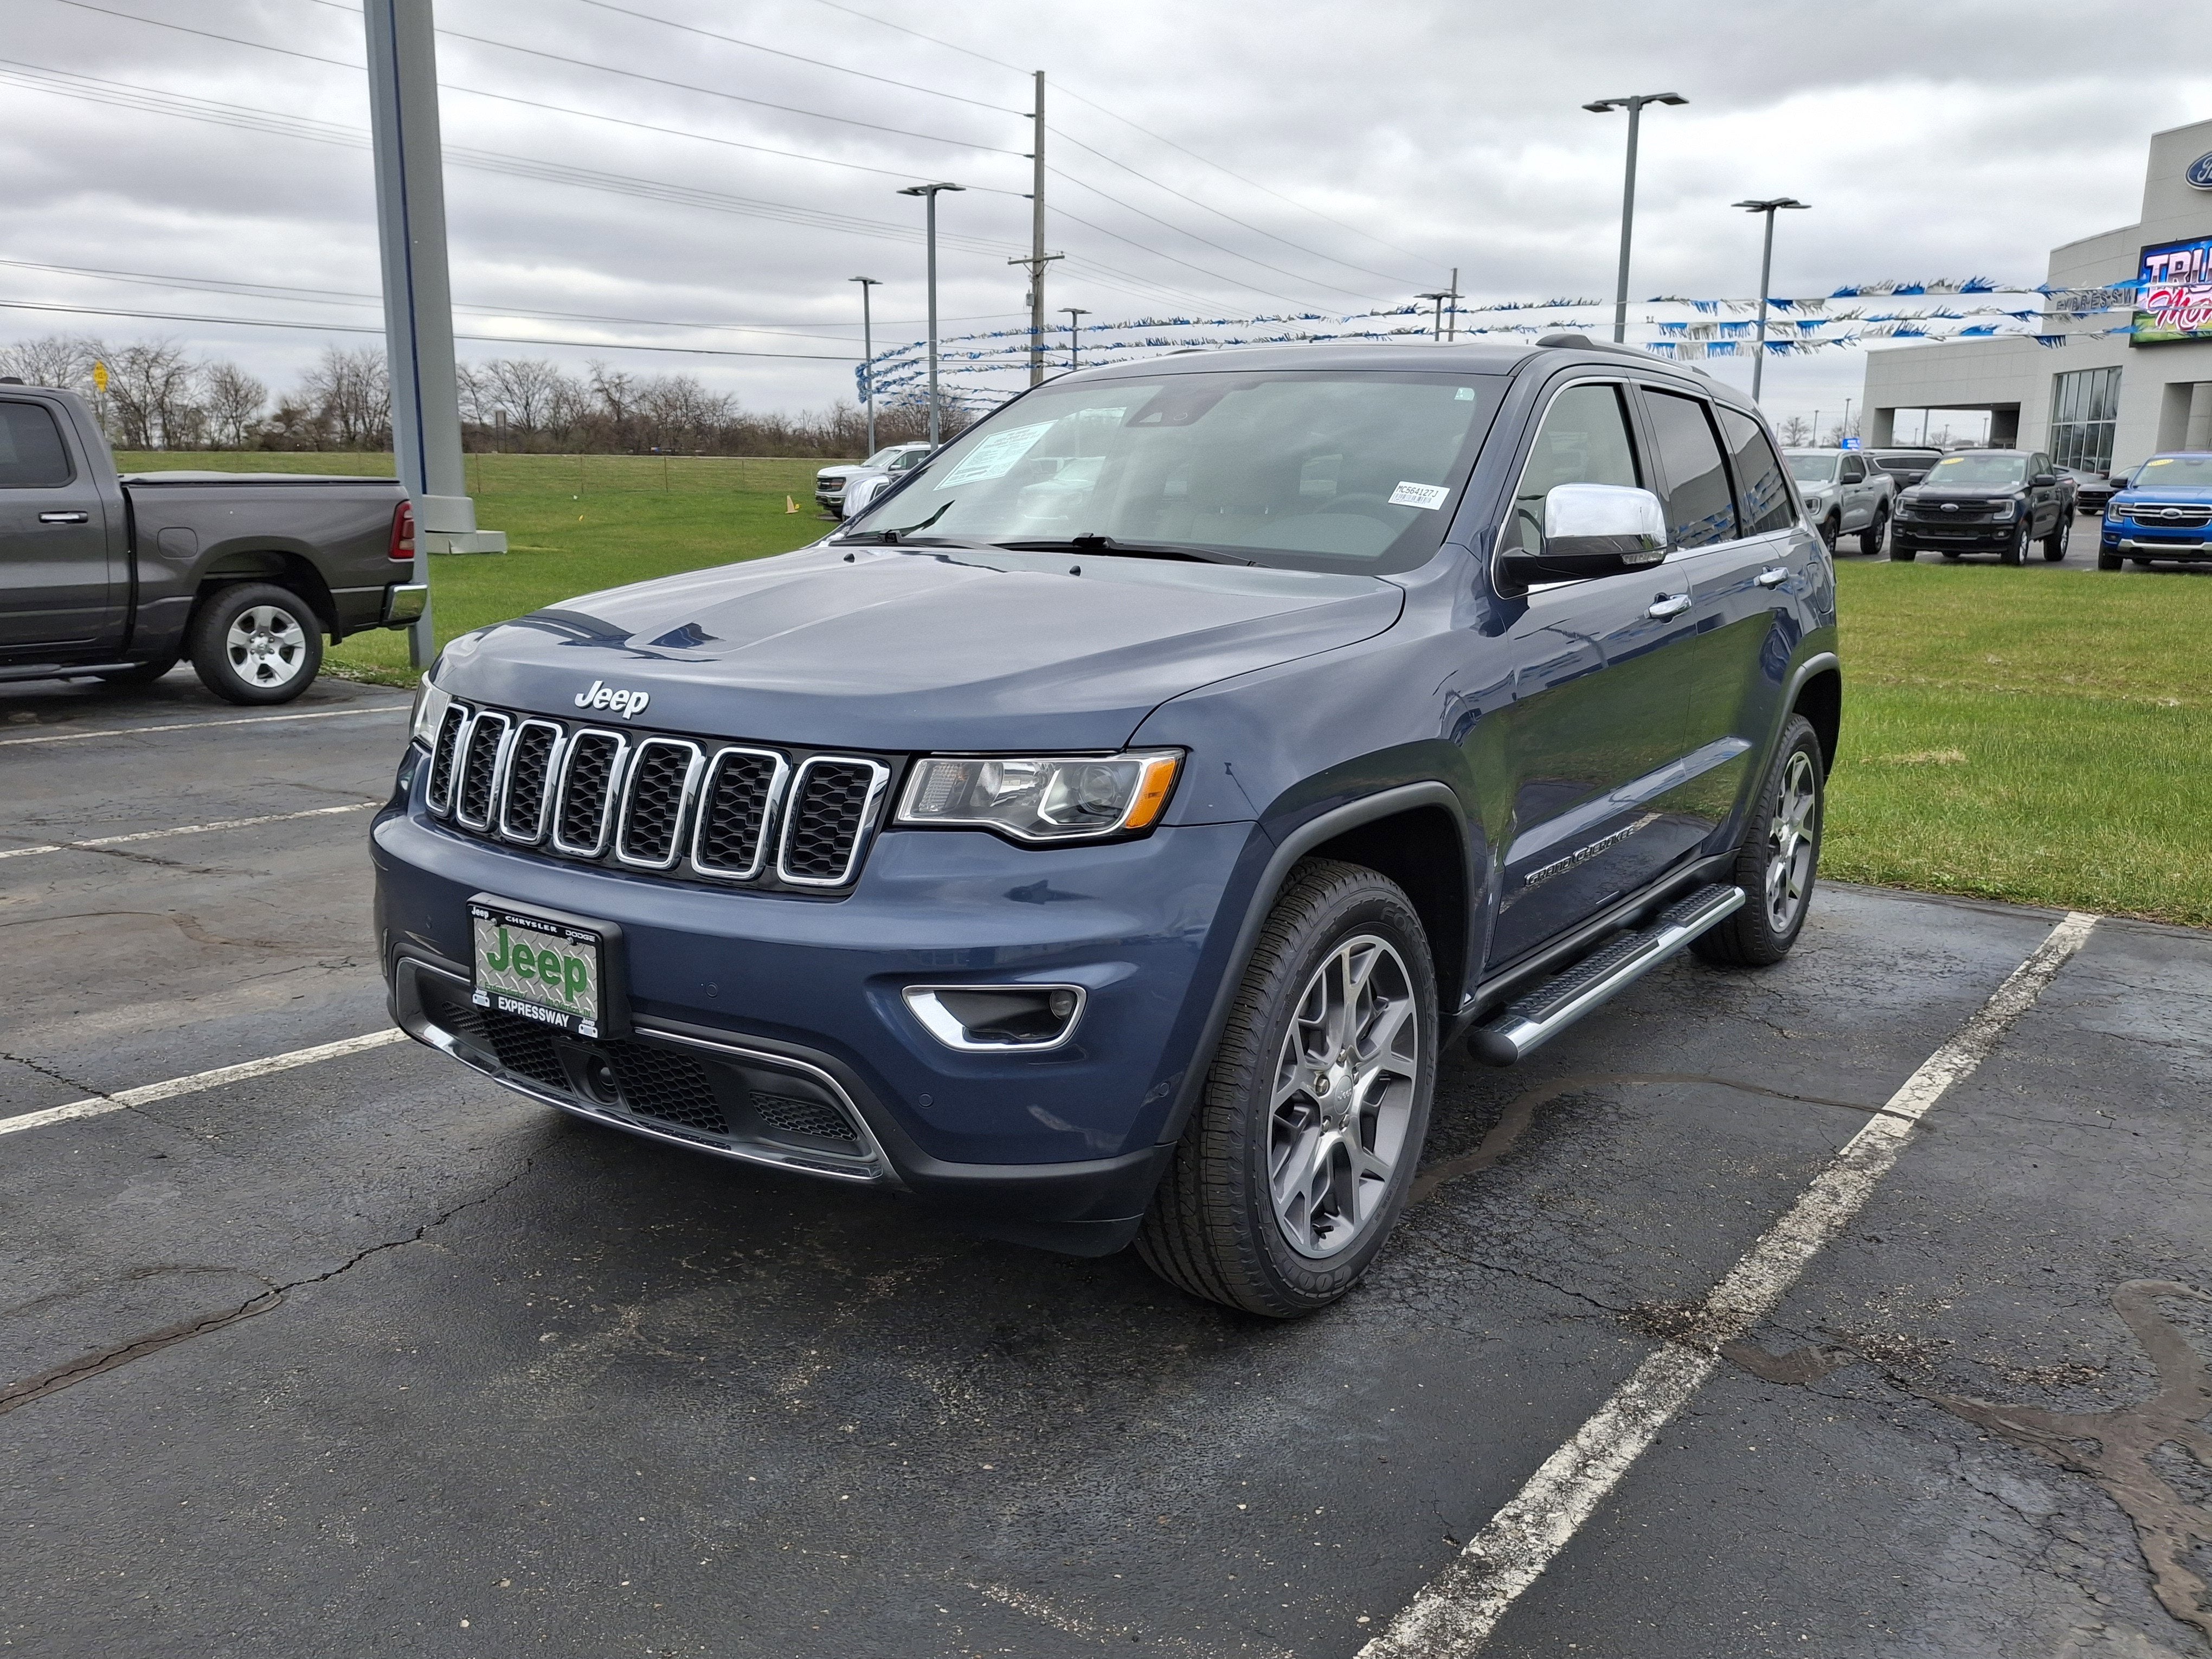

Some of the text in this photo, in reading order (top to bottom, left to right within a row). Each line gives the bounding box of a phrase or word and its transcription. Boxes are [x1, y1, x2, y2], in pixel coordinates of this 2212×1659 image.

[574, 680, 650, 720] Jeep
[1525, 824, 1635, 886] GRAND CHEROKEE
[472, 906, 595, 942] Jeep CHRYSLER DODGE
[486, 927, 587, 1002] Jeep
[475, 987, 487, 996] Jeep
[498, 996, 569, 1027] EXPRESSWAY
[581, 1017, 595, 1026] Jeep
